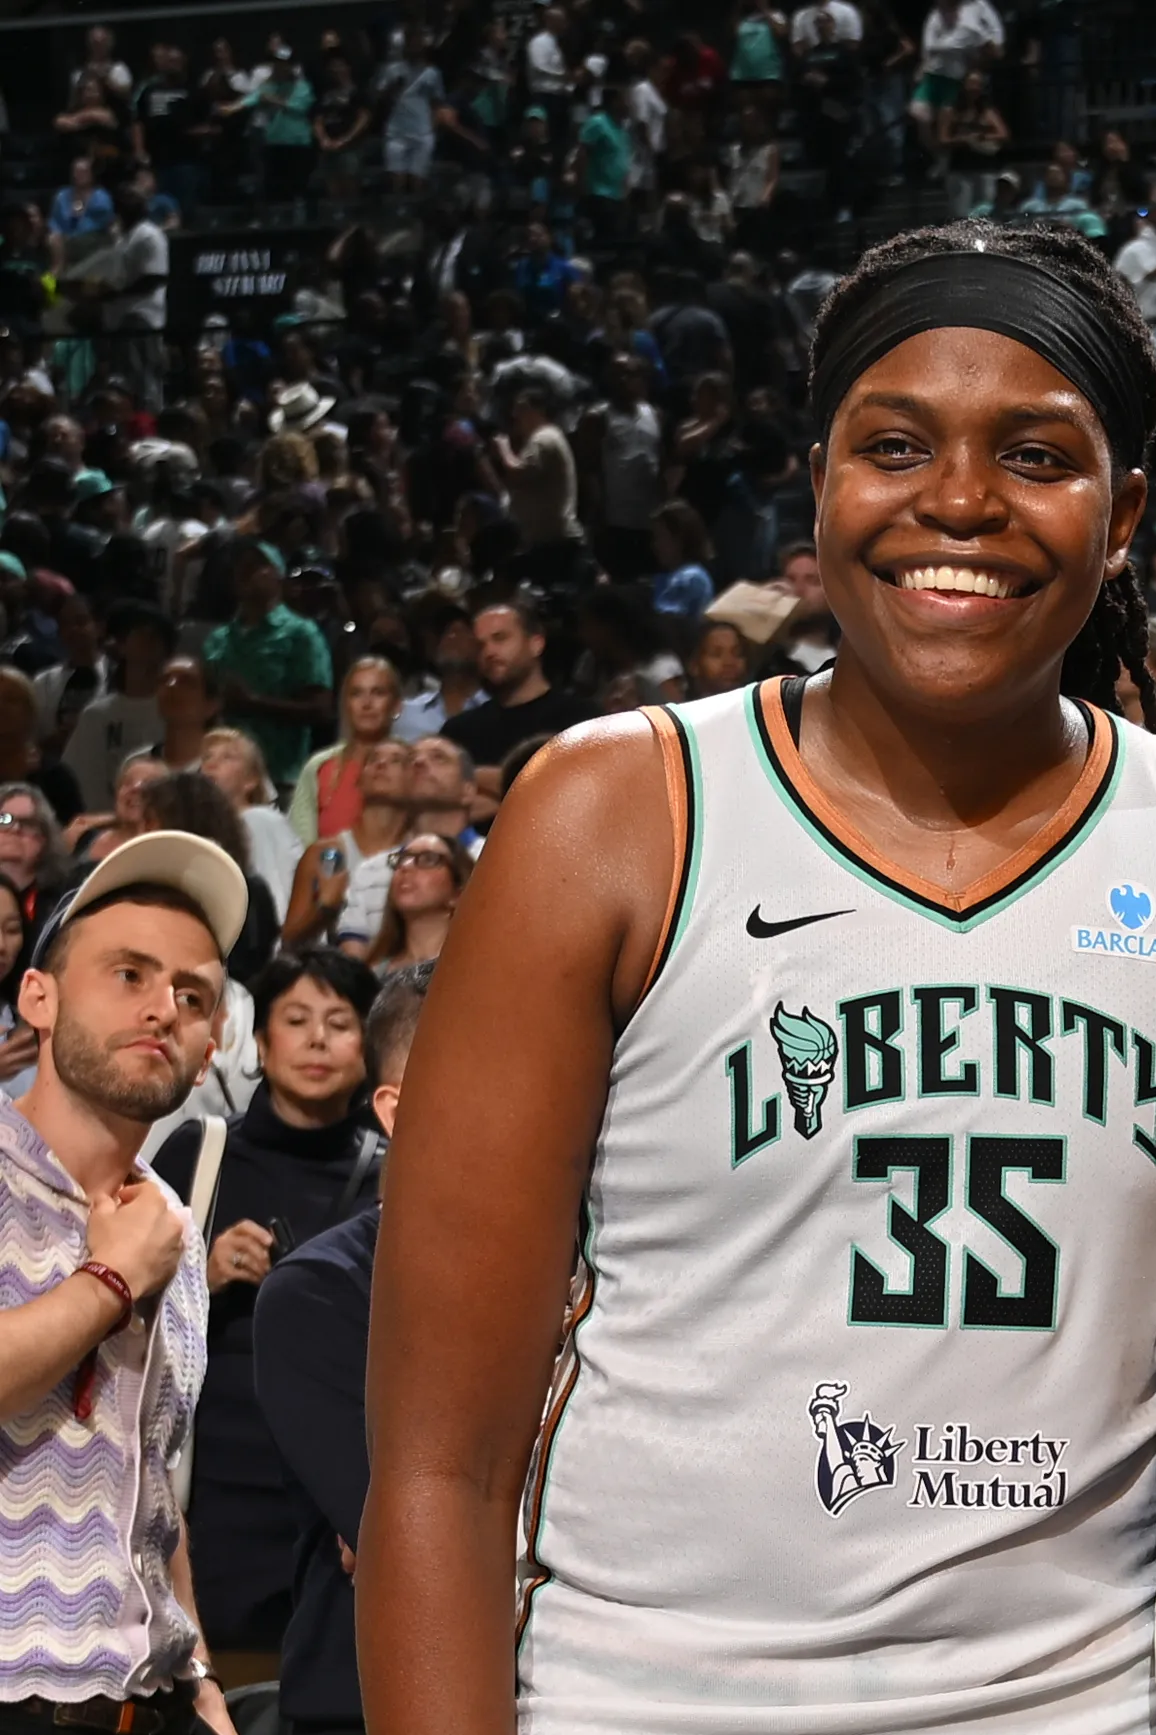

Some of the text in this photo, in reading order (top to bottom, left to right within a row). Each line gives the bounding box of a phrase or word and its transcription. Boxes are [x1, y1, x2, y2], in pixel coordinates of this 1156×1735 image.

[846, 1132, 1069, 1333] 35
[914, 1424, 1069, 1481] Liberty
[908, 1470, 1067, 1508] Mutual
